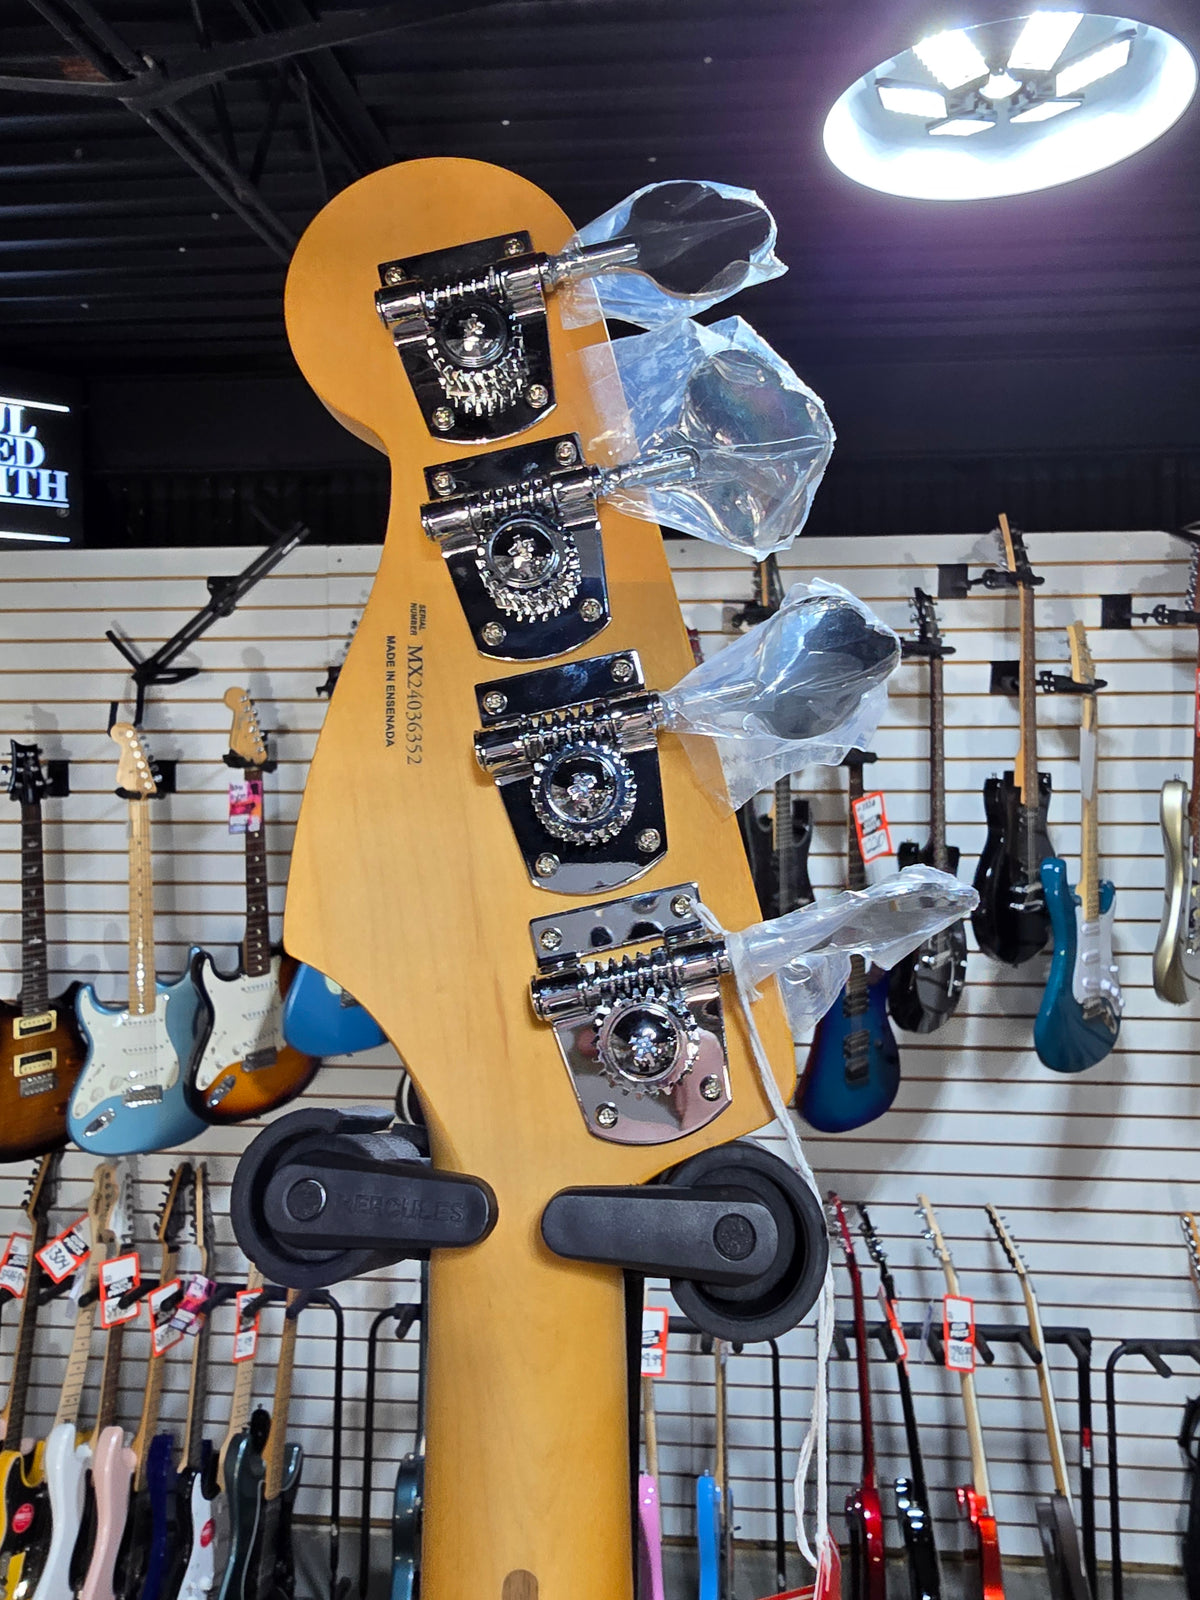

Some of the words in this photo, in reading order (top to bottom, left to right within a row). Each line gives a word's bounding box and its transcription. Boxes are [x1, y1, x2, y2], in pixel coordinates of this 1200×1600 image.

[409, 602, 418, 636] NUMBER
[419, 603, 427, 630] SERIAL
[386, 635, 397, 668] MADE
[386, 670, 396, 682] IN
[385, 684, 396, 748] ENSENADA
[406, 645, 424, 765] MX24036352
